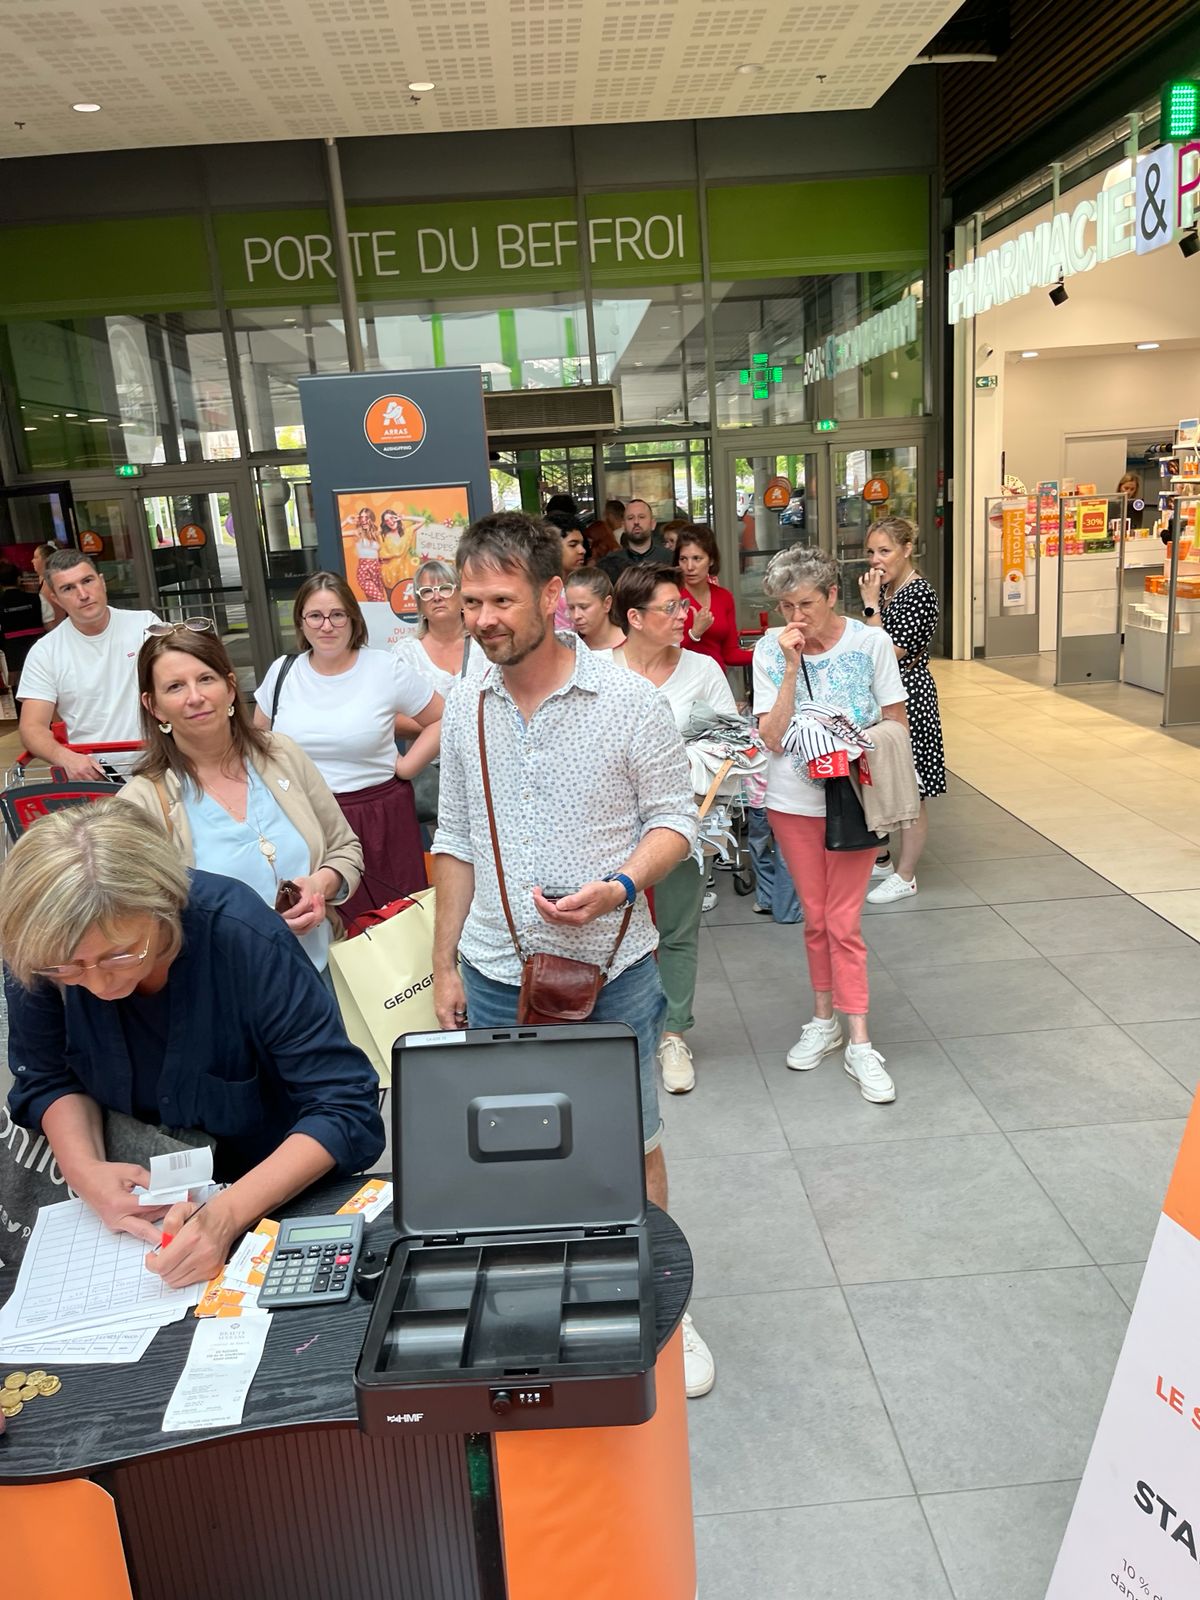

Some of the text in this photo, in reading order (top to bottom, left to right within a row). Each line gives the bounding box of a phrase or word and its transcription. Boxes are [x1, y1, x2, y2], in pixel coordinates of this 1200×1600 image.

[243, 213, 684, 282] PORTE DU BEFFROI
[948, 177, 1136, 324] PHARMACIE
[1140, 162, 1168, 241] &
[383, 428, 409, 436] ARRAS
[1010, 511, 1024, 565] Hydratis
[1155, 1375, 1185, 1415] LE
[398, 1413, 424, 1423] HMF
[1133, 1480, 1200, 1562] STA
[1110, 1573, 1140, 1600] dan
[1122, 1558, 1136, 1580] 10
